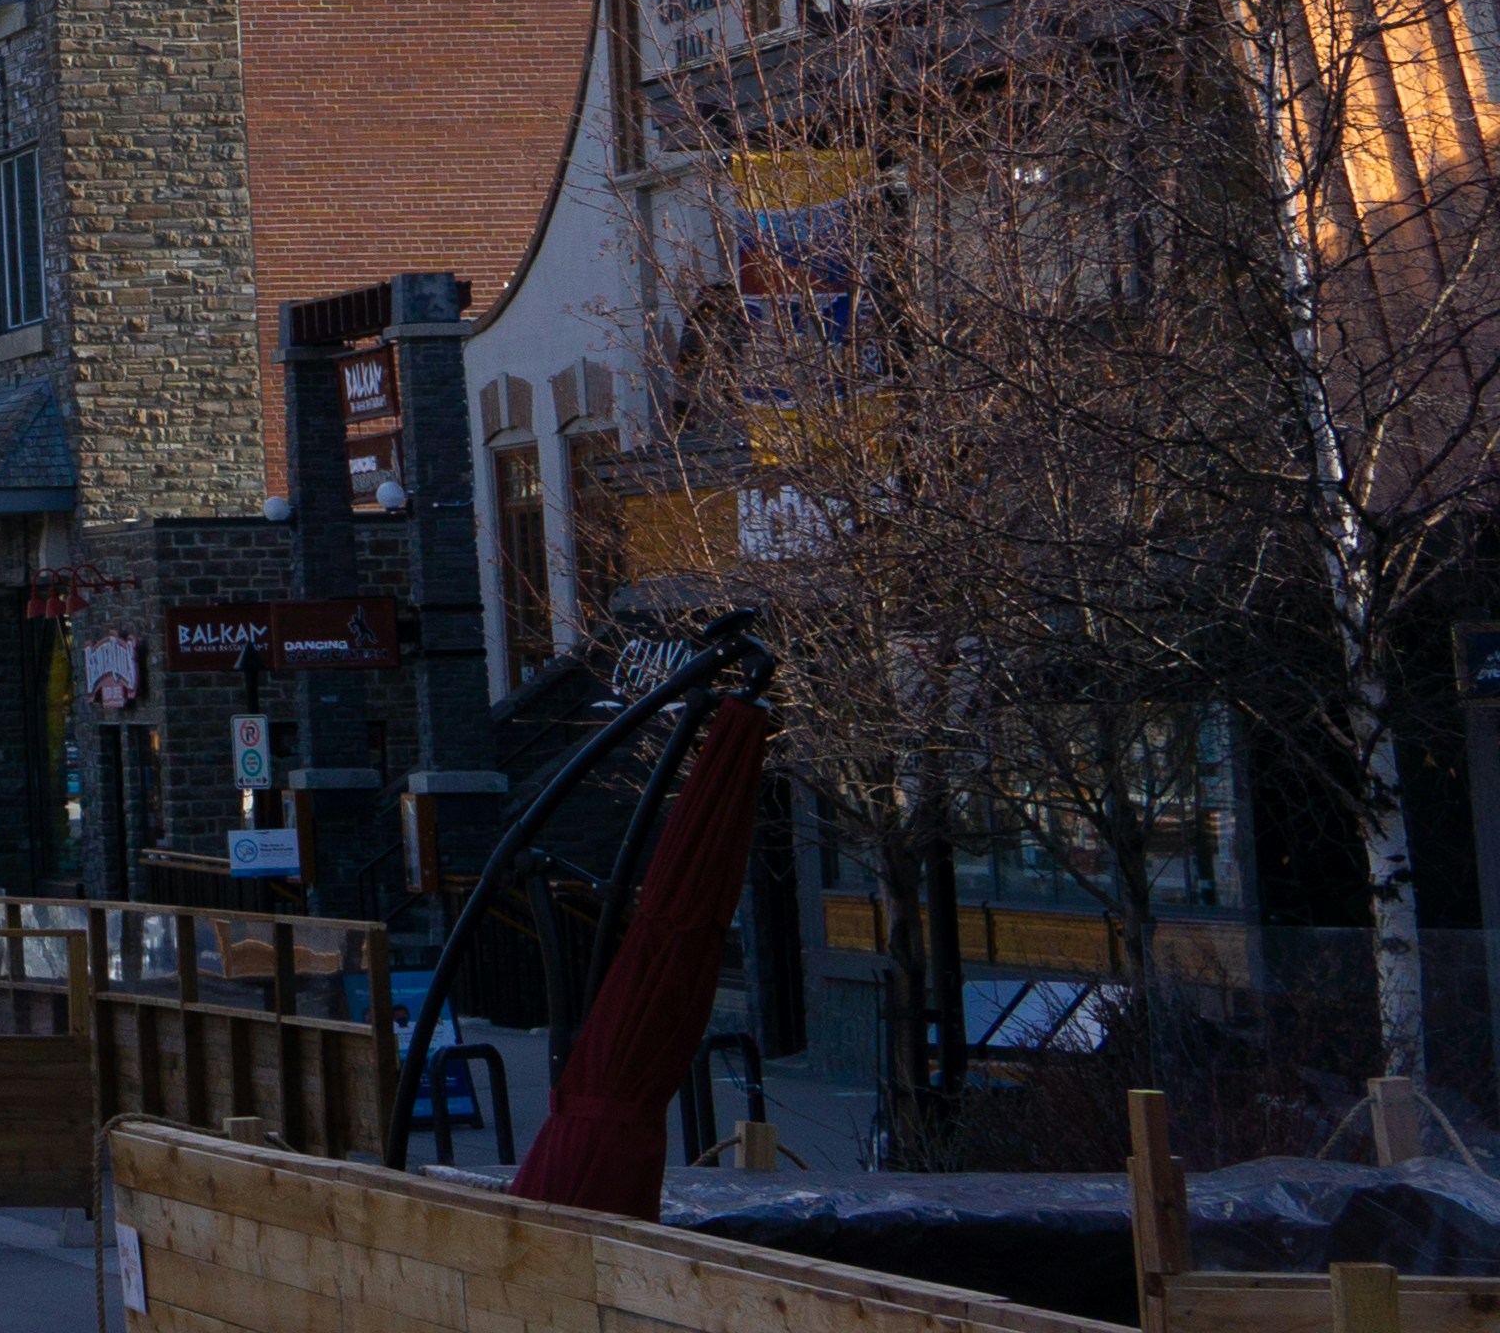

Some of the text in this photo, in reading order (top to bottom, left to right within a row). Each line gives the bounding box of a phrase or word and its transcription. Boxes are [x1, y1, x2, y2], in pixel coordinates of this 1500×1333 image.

[344, 359, 383, 400] BALKAN
[178, 623, 268, 645] BALKAN
[284, 640, 349, 651] DANCING
[285, 648, 389, 662] SASQUATCH
